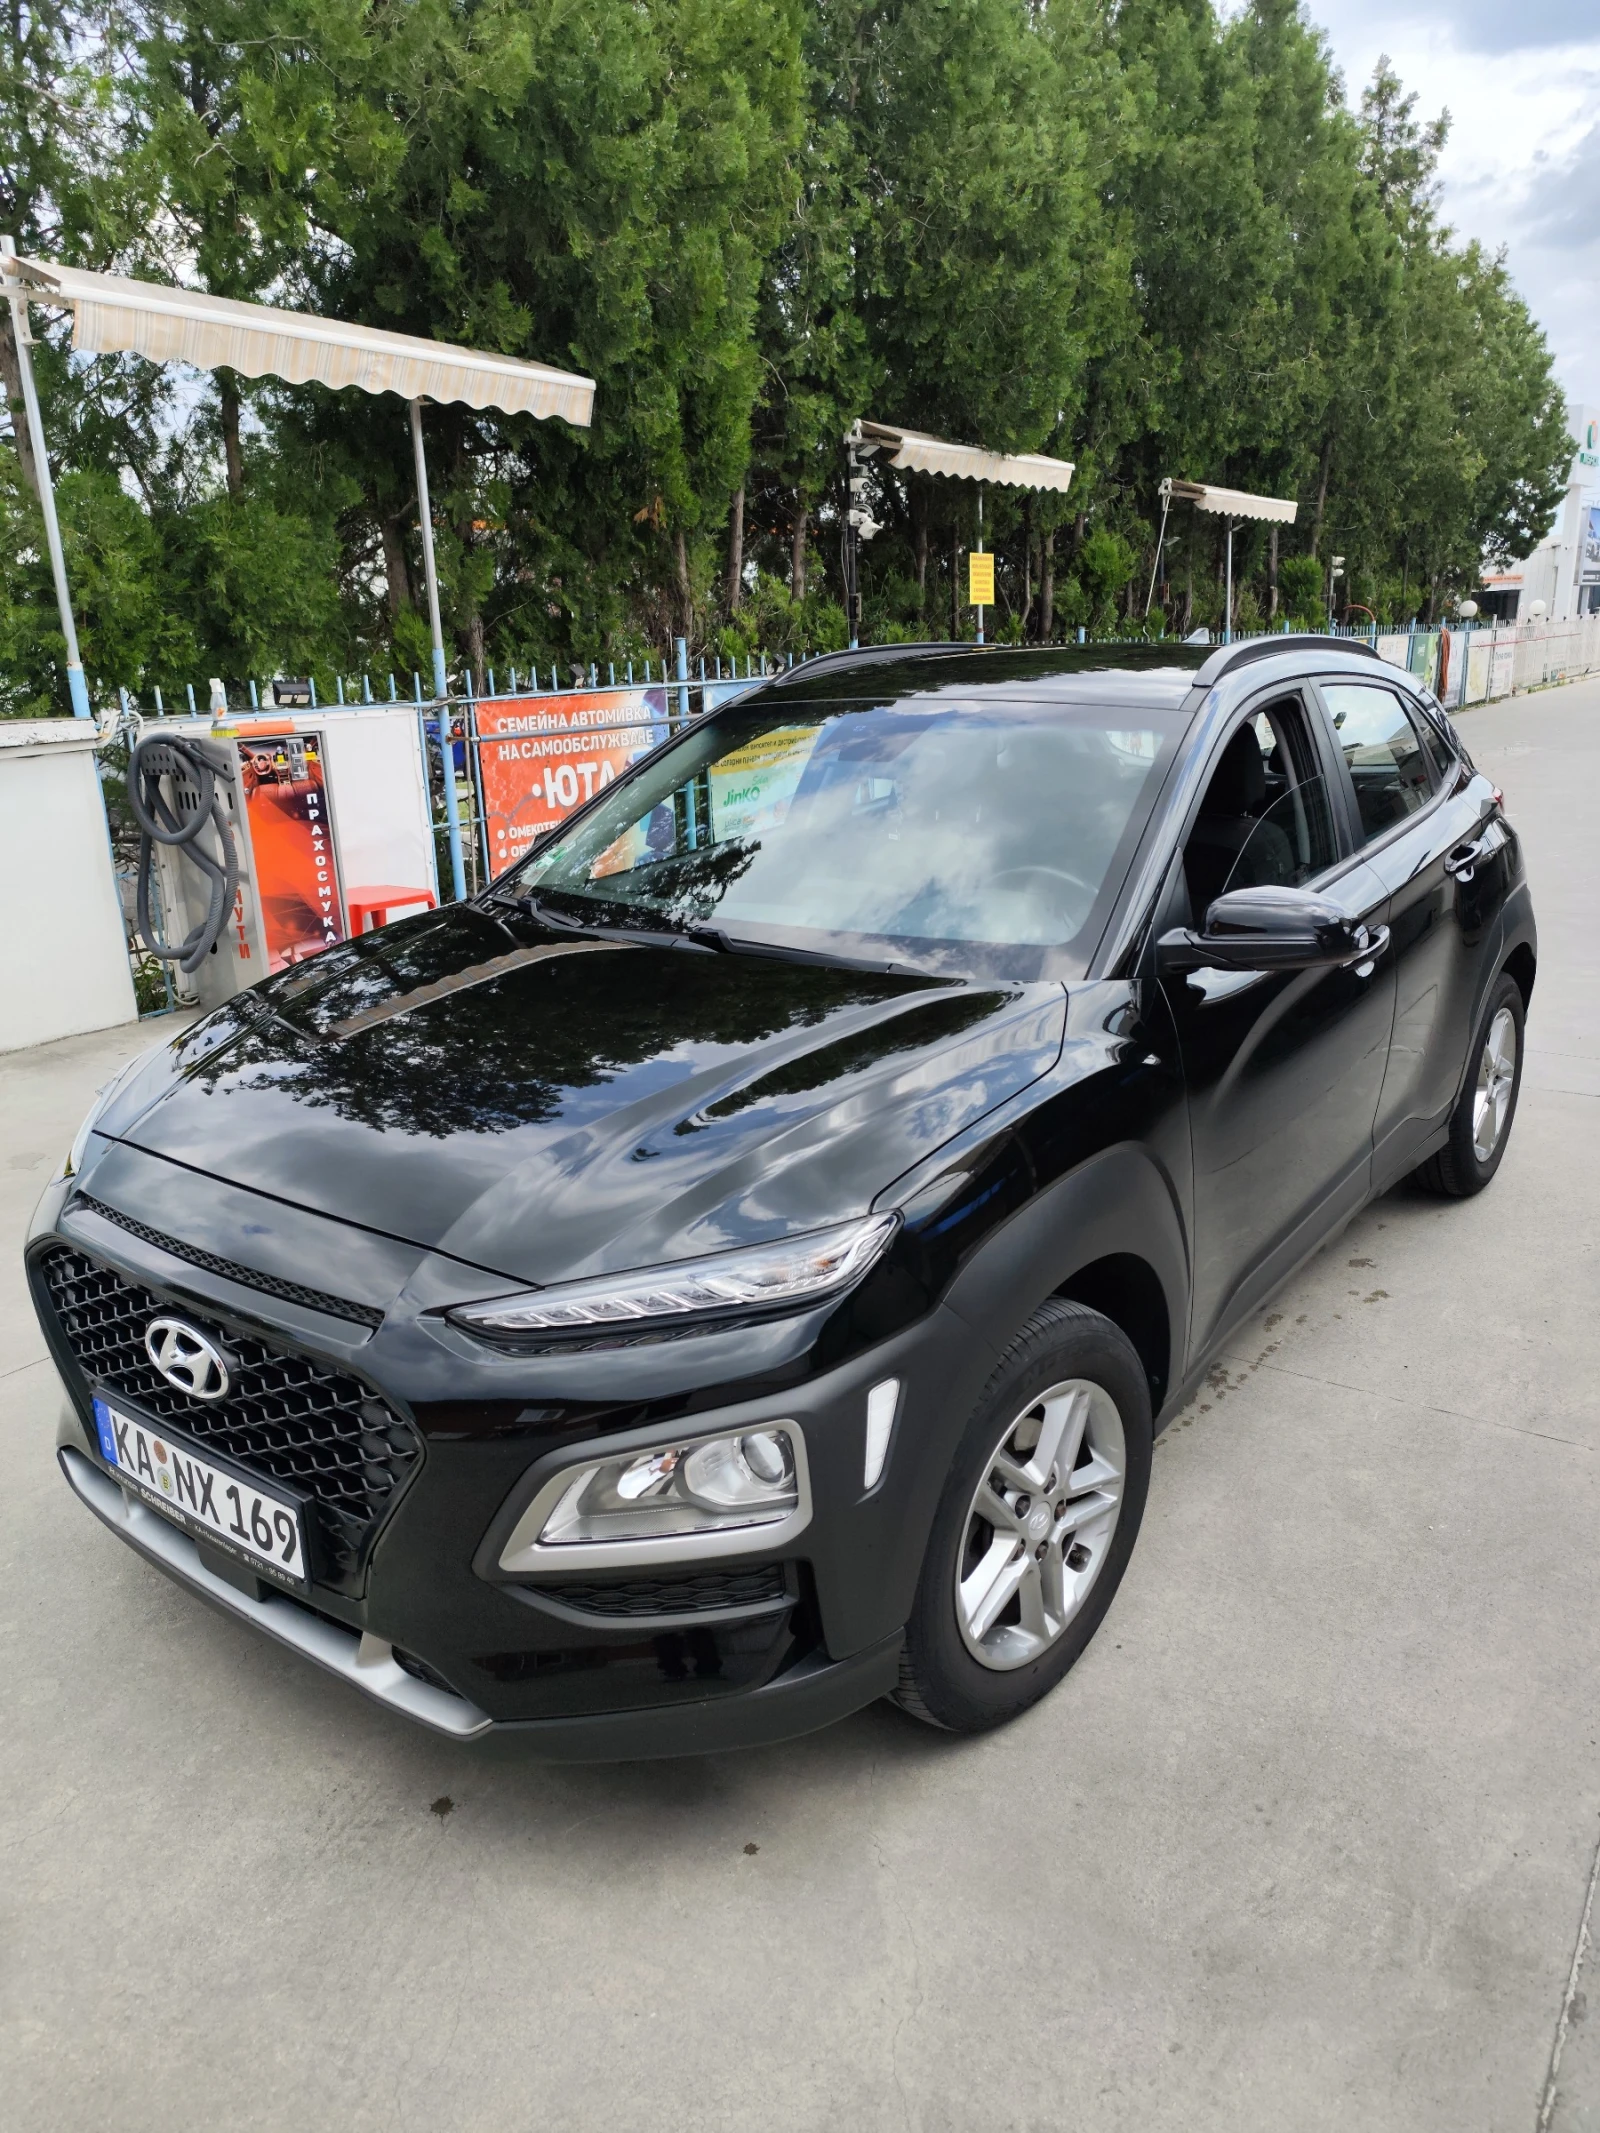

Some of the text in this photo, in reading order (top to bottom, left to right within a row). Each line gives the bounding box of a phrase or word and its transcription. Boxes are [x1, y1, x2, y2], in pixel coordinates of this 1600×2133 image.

[496, 706, 652, 733] СЕМЕЙНА АВТОМИВКА
[499, 729, 654, 760] НА САМООБСЛУЖВАНЕ
[306, 793, 336, 943] ПРАХОСМУКА
[112, 1414, 297, 1564] KA NX 169
[140, 1487, 187, 1525] SCHREIBER
